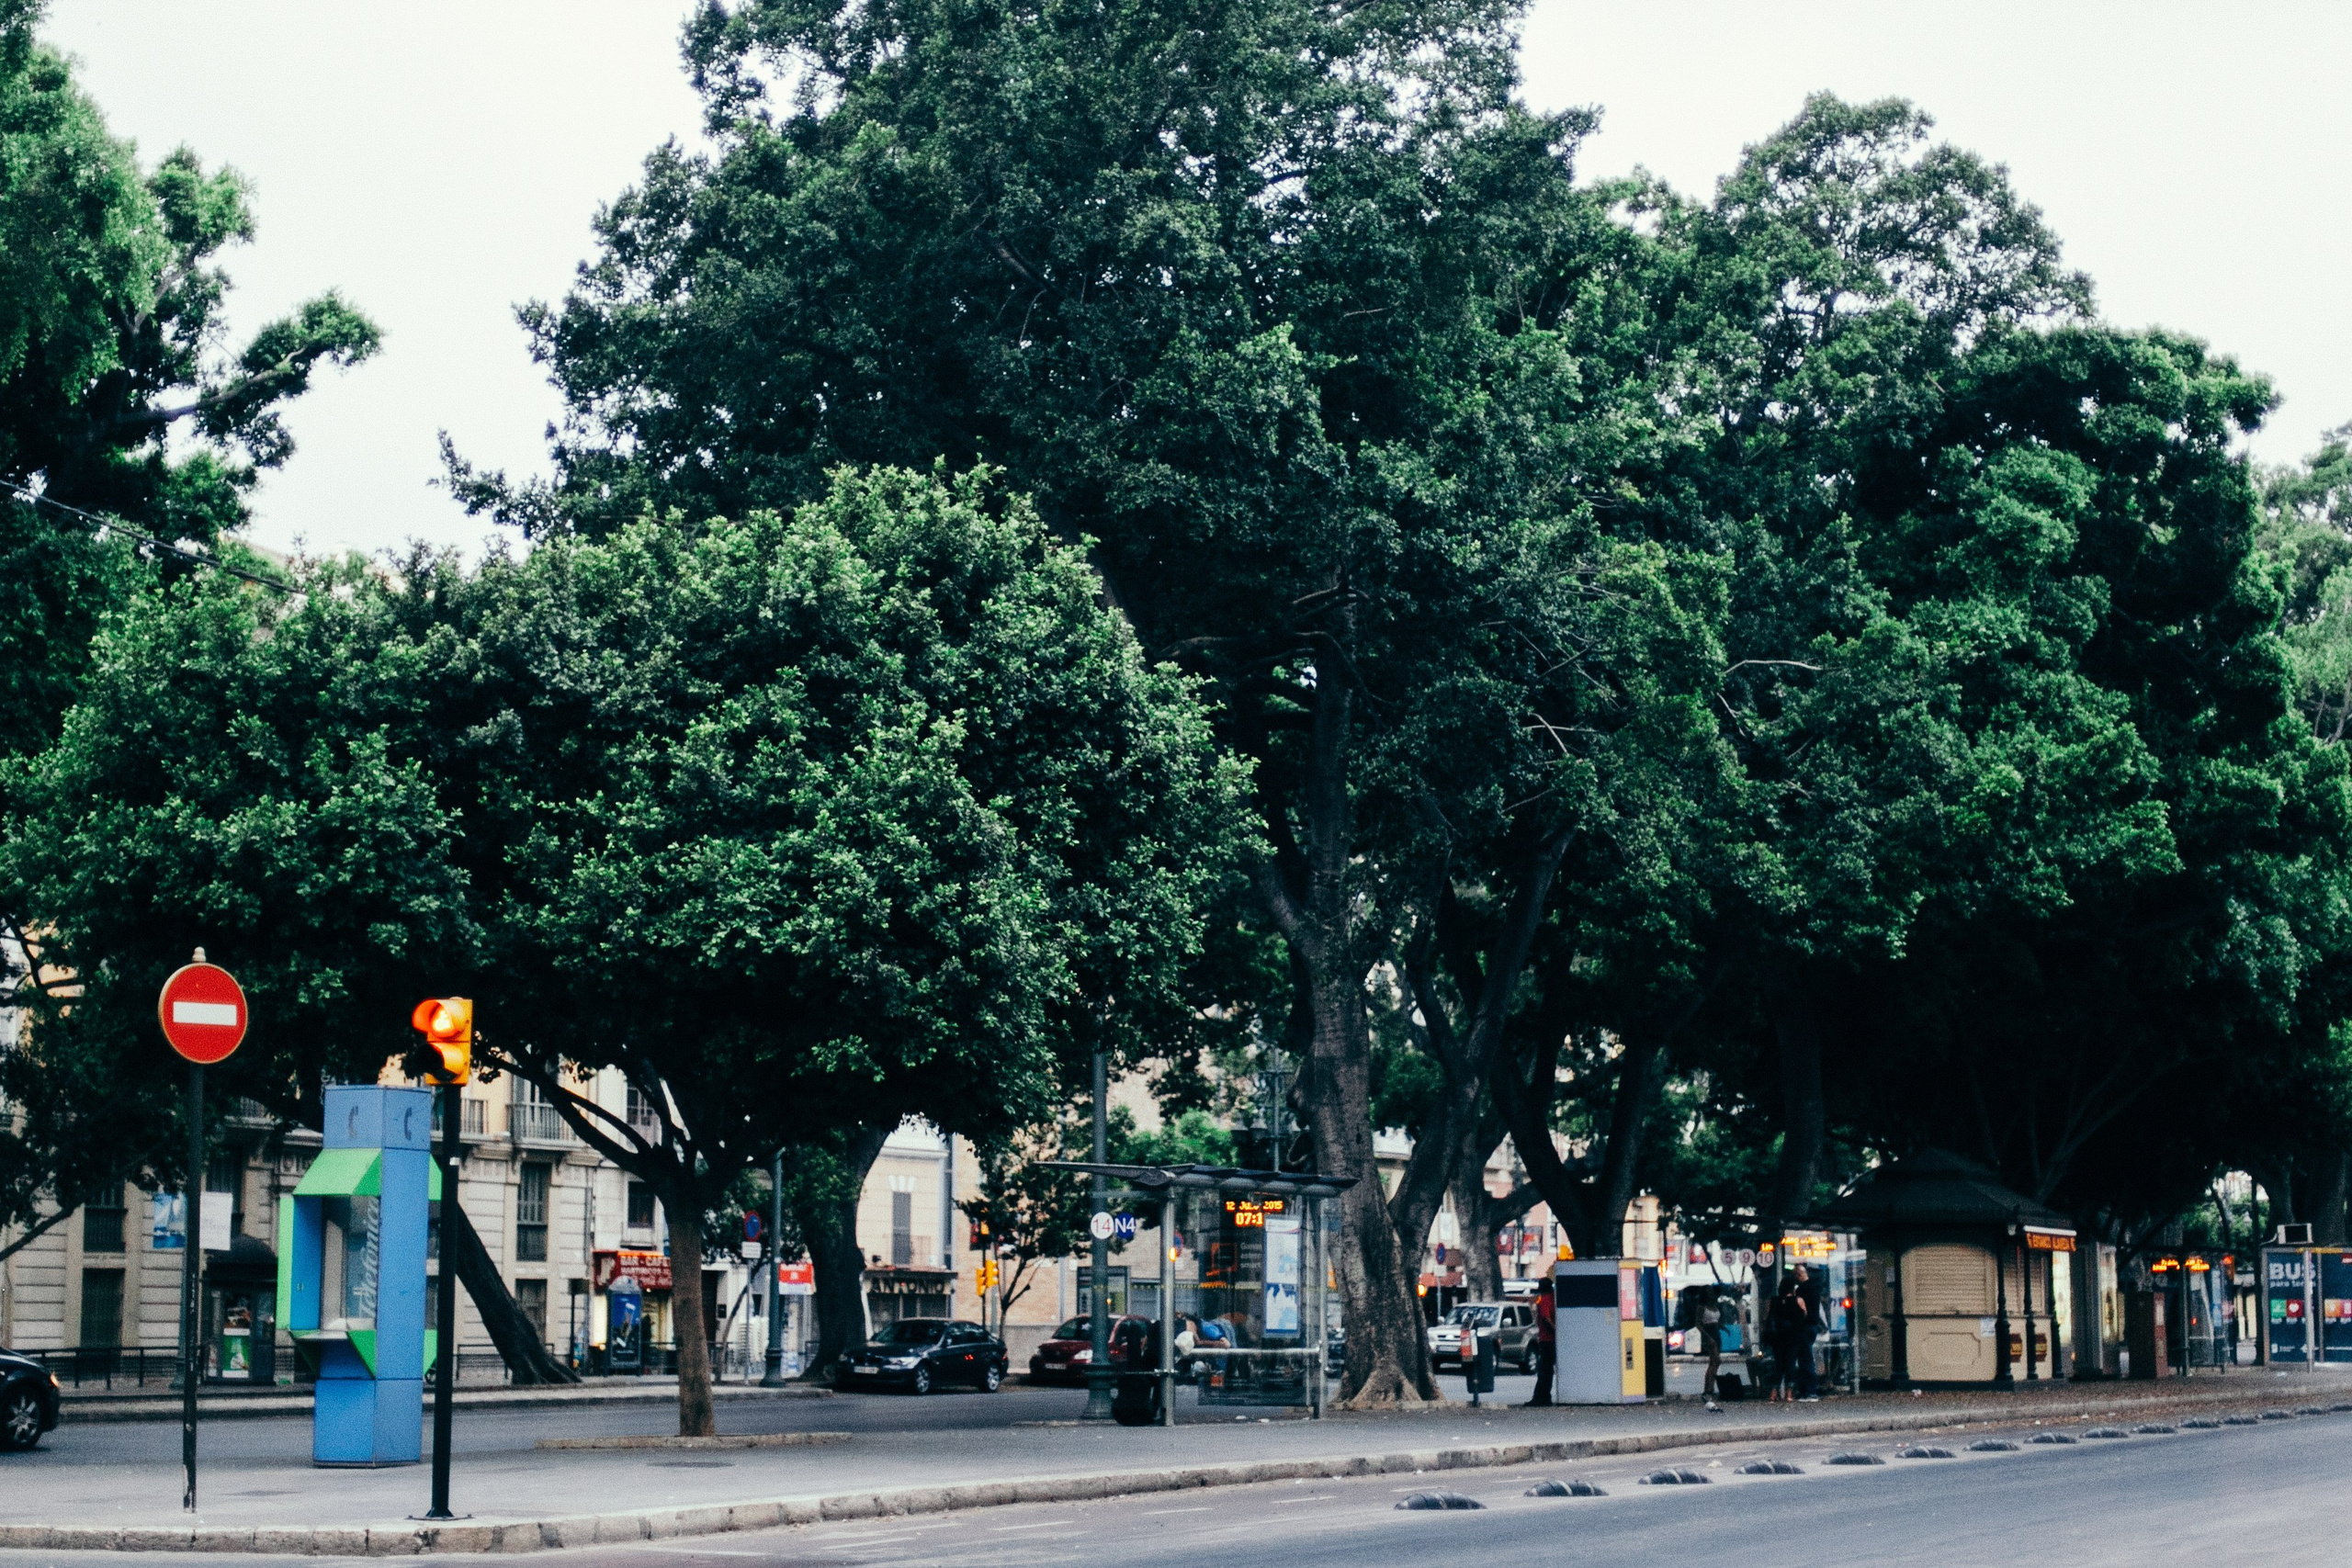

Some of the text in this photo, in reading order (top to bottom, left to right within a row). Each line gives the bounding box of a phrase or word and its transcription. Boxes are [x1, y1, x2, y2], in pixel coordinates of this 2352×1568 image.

[1226, 1201, 1236, 1211] 12
[1263, 1200, 1283, 1210] 2015
[1114, 1216, 1136, 1233] N4
[1236, 1212, 1263, 1225] 07:1
[1093, 1218, 1111, 1233] 14
[1724, 1252, 1733, 1262] 5
[1743, 1252, 1751, 1262] 9
[1758, 1252, 1773, 1262] 10
[2269, 1262, 2316, 1280] BUS
